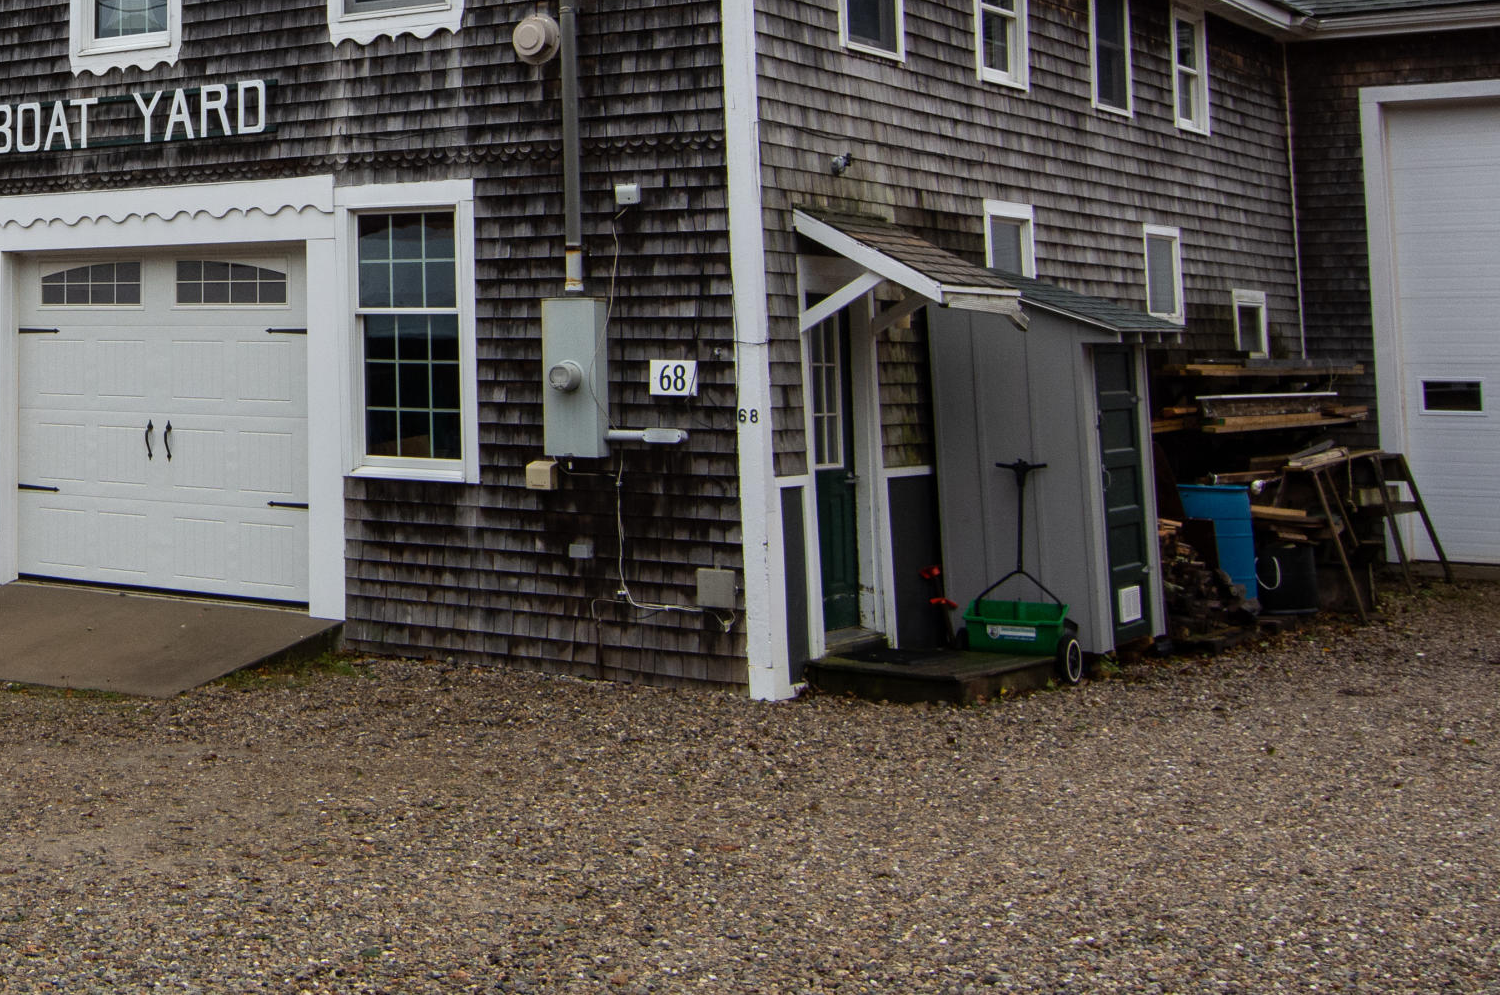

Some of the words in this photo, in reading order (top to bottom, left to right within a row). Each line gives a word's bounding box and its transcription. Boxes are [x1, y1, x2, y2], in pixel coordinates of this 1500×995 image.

[133, 79, 267, 143] YARD
[659, 364, 686, 391] 68
[738, 408, 759, 424] 68
